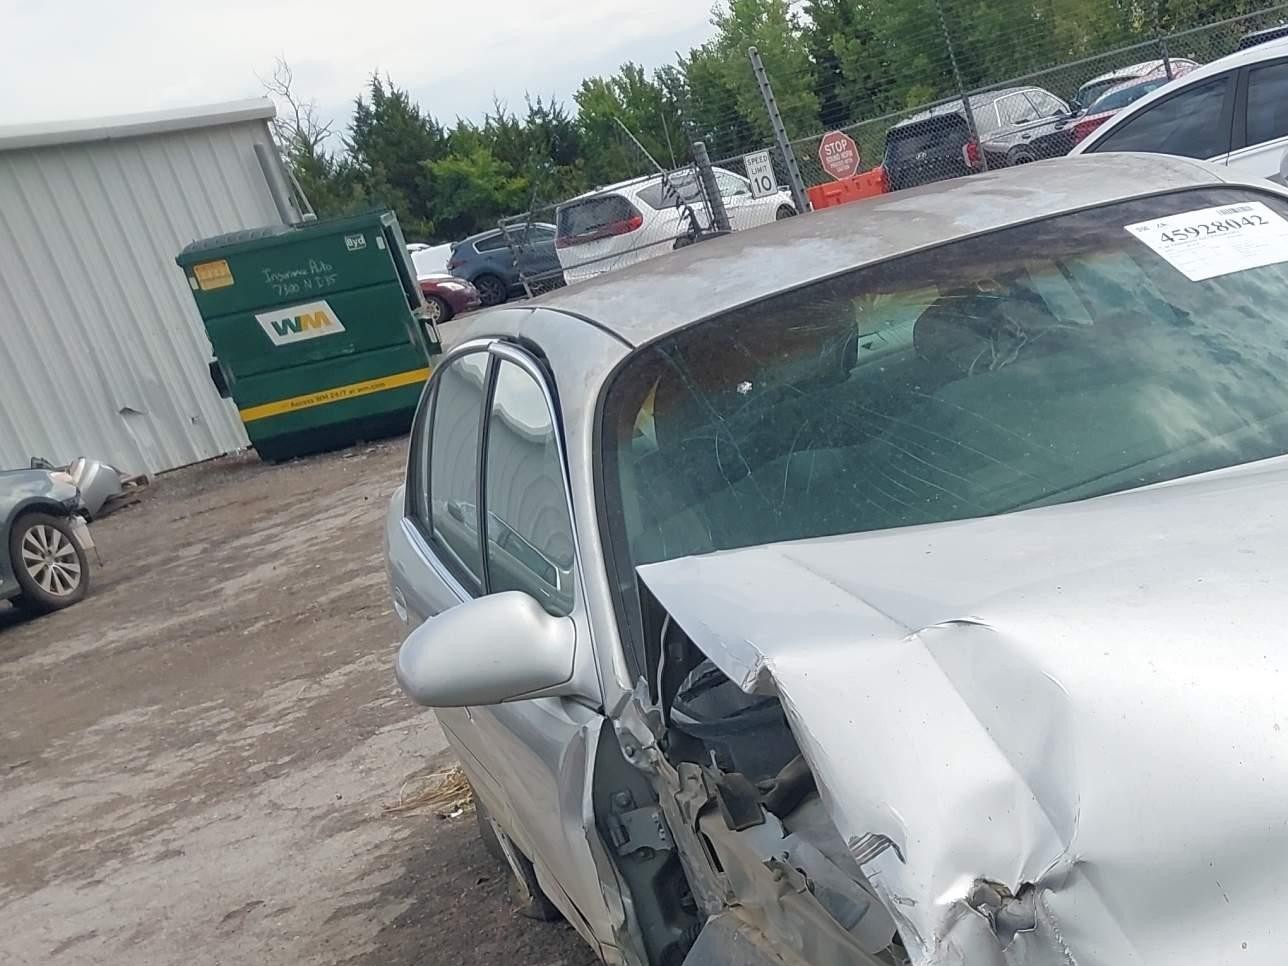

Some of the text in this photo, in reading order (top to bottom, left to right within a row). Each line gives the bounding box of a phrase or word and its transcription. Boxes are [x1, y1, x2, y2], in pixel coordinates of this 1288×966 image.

[824, 139, 848, 156] STOP
[746, 154, 768, 166] SPEED
[752, 165, 767, 175] LIMIT
[754, 175, 772, 194] 10
[1160, 214, 1270, 243] 45928042
[270, 311, 332, 336] WM
